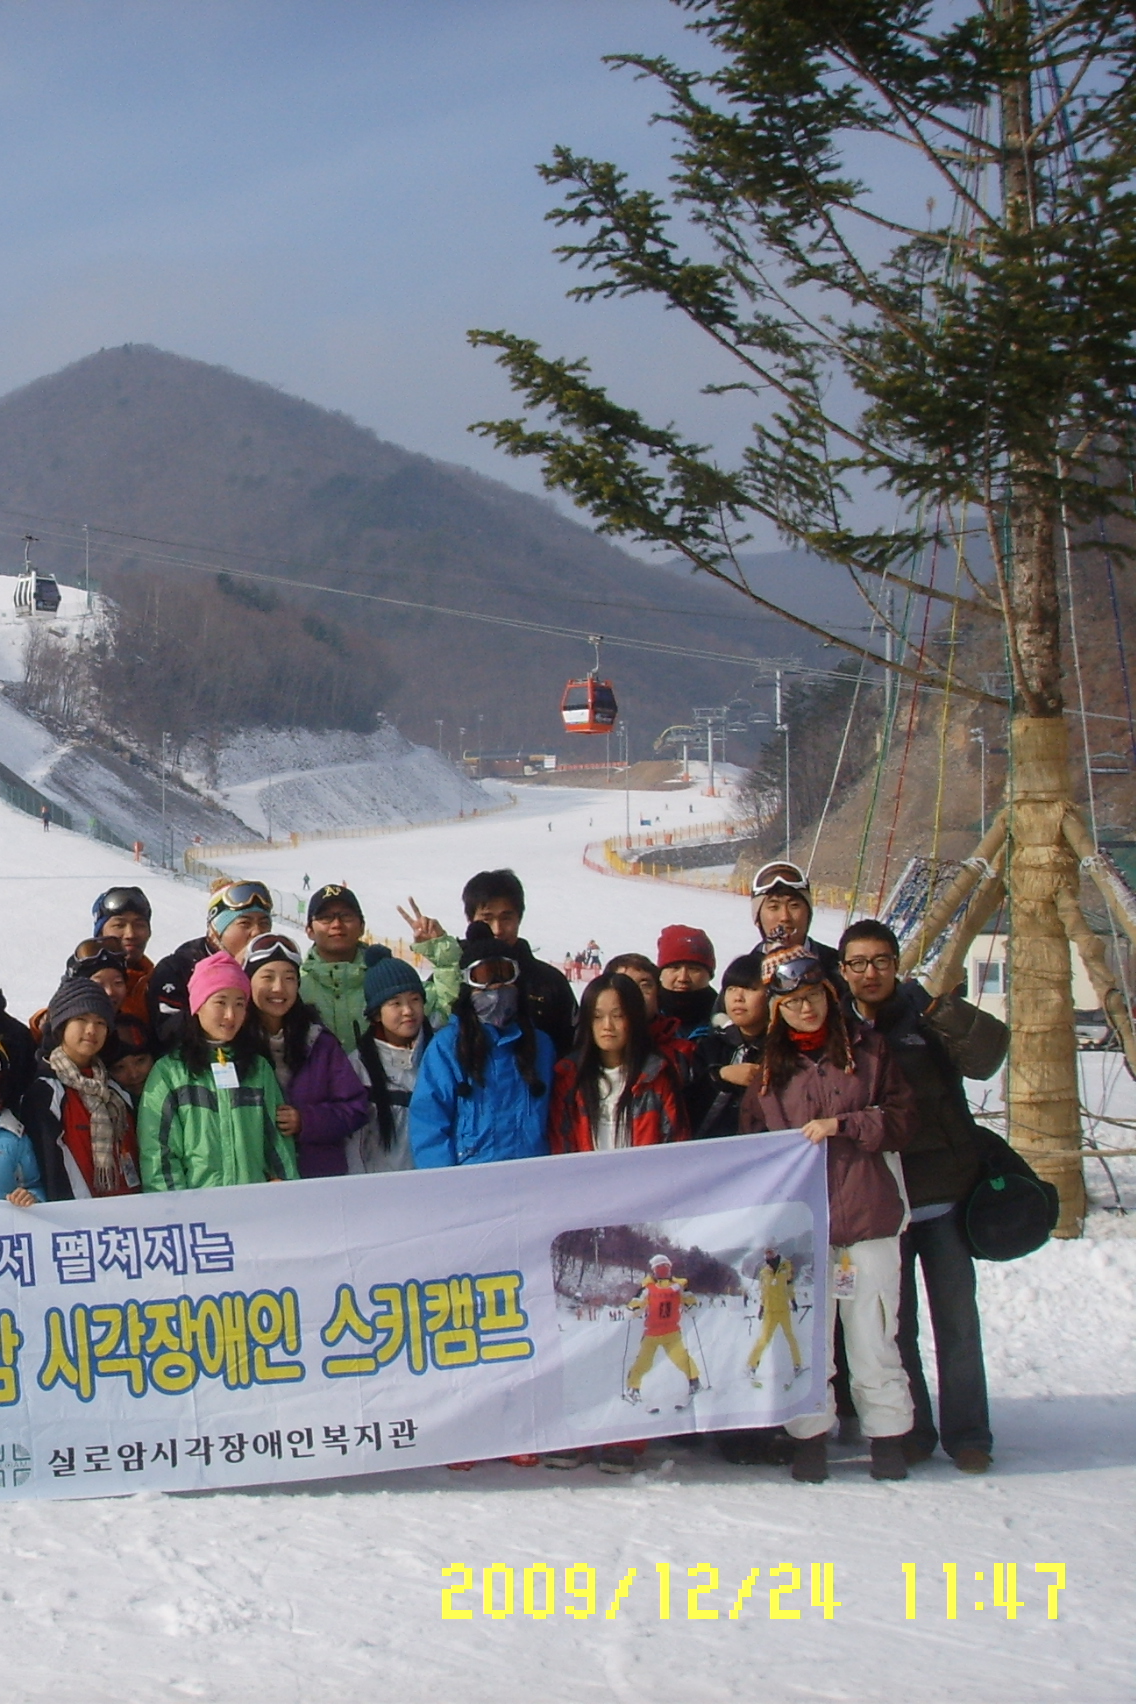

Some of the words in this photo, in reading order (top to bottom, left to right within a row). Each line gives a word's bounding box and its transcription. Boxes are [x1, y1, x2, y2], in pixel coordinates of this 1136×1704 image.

[52, 1222, 235, 1284] 펼쳐지는
[38, 1287, 306, 1401] 시각장애인
[322, 1270, 535, 1377] 스키캠프
[48, 1418, 418, 1477] 실로암시각장애인복지관
